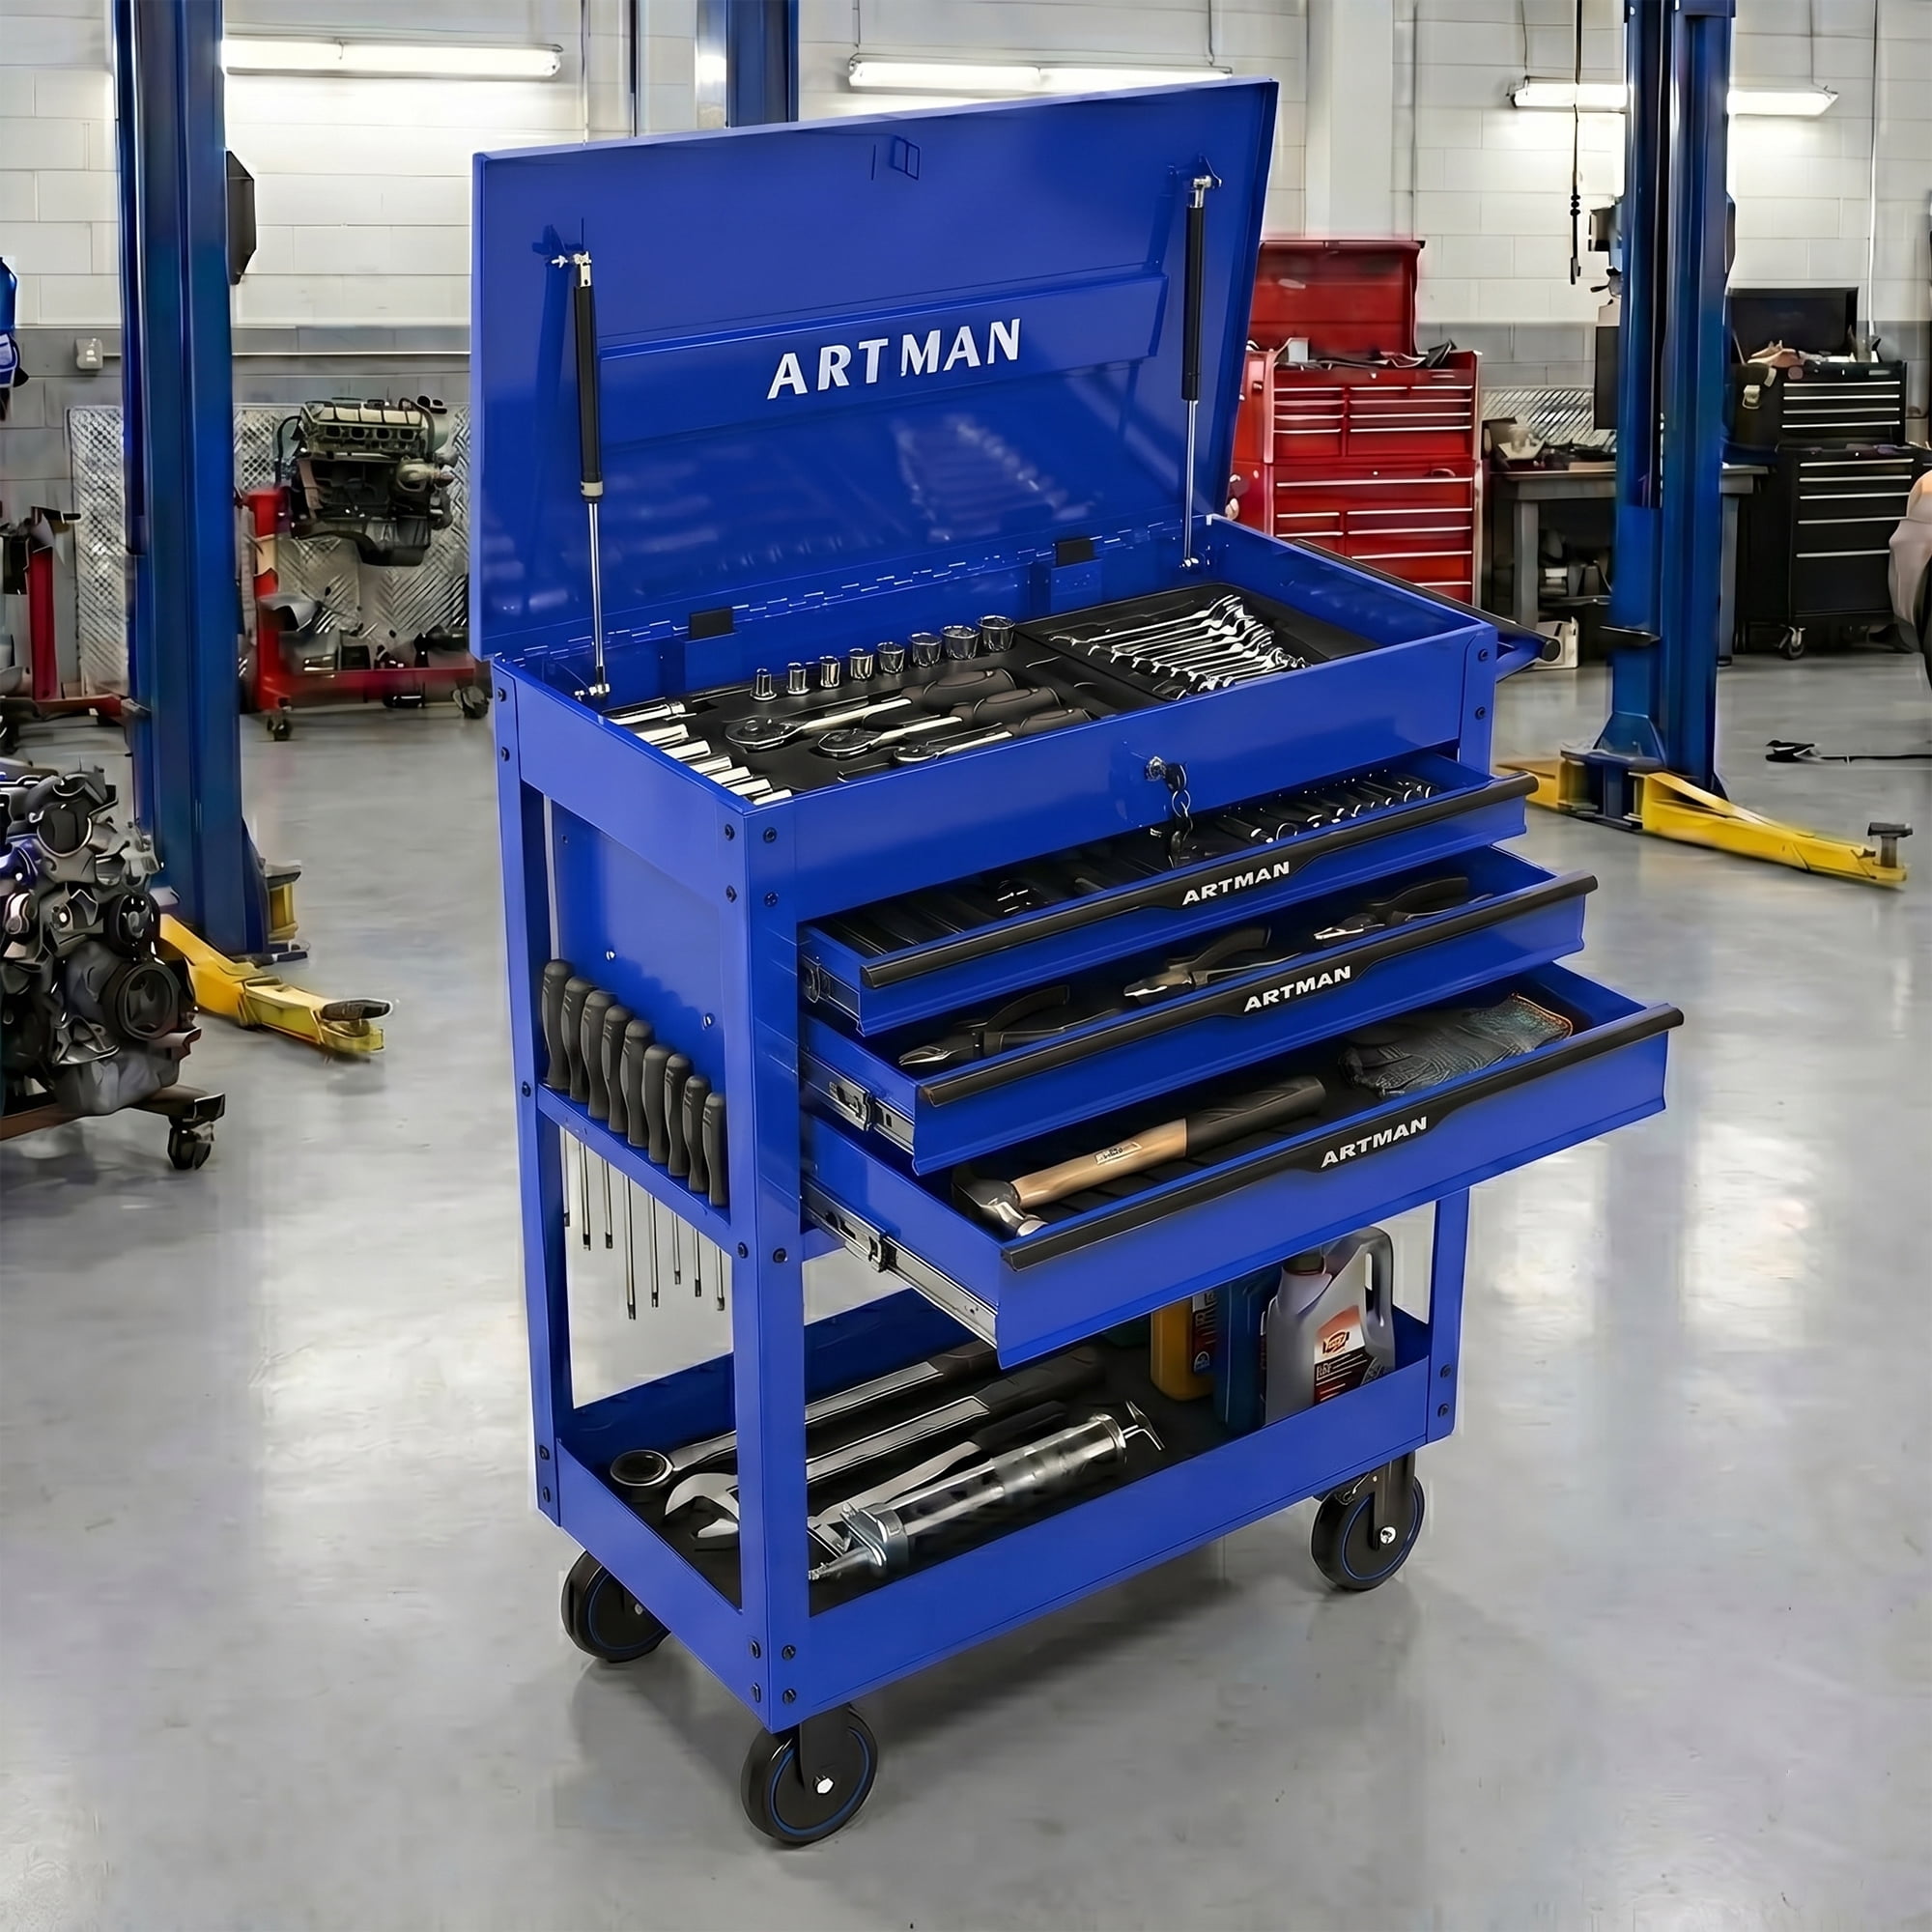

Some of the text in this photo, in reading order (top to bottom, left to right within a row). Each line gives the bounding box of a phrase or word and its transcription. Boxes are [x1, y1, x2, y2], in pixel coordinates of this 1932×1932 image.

[766, 318, 1021, 400] ARTMAN
[1181, 861, 1290, 906] ARTMAN
[1243, 965, 1350, 1012] ARTMAN
[1321, 1116, 1427, 1168] ARTMAN
